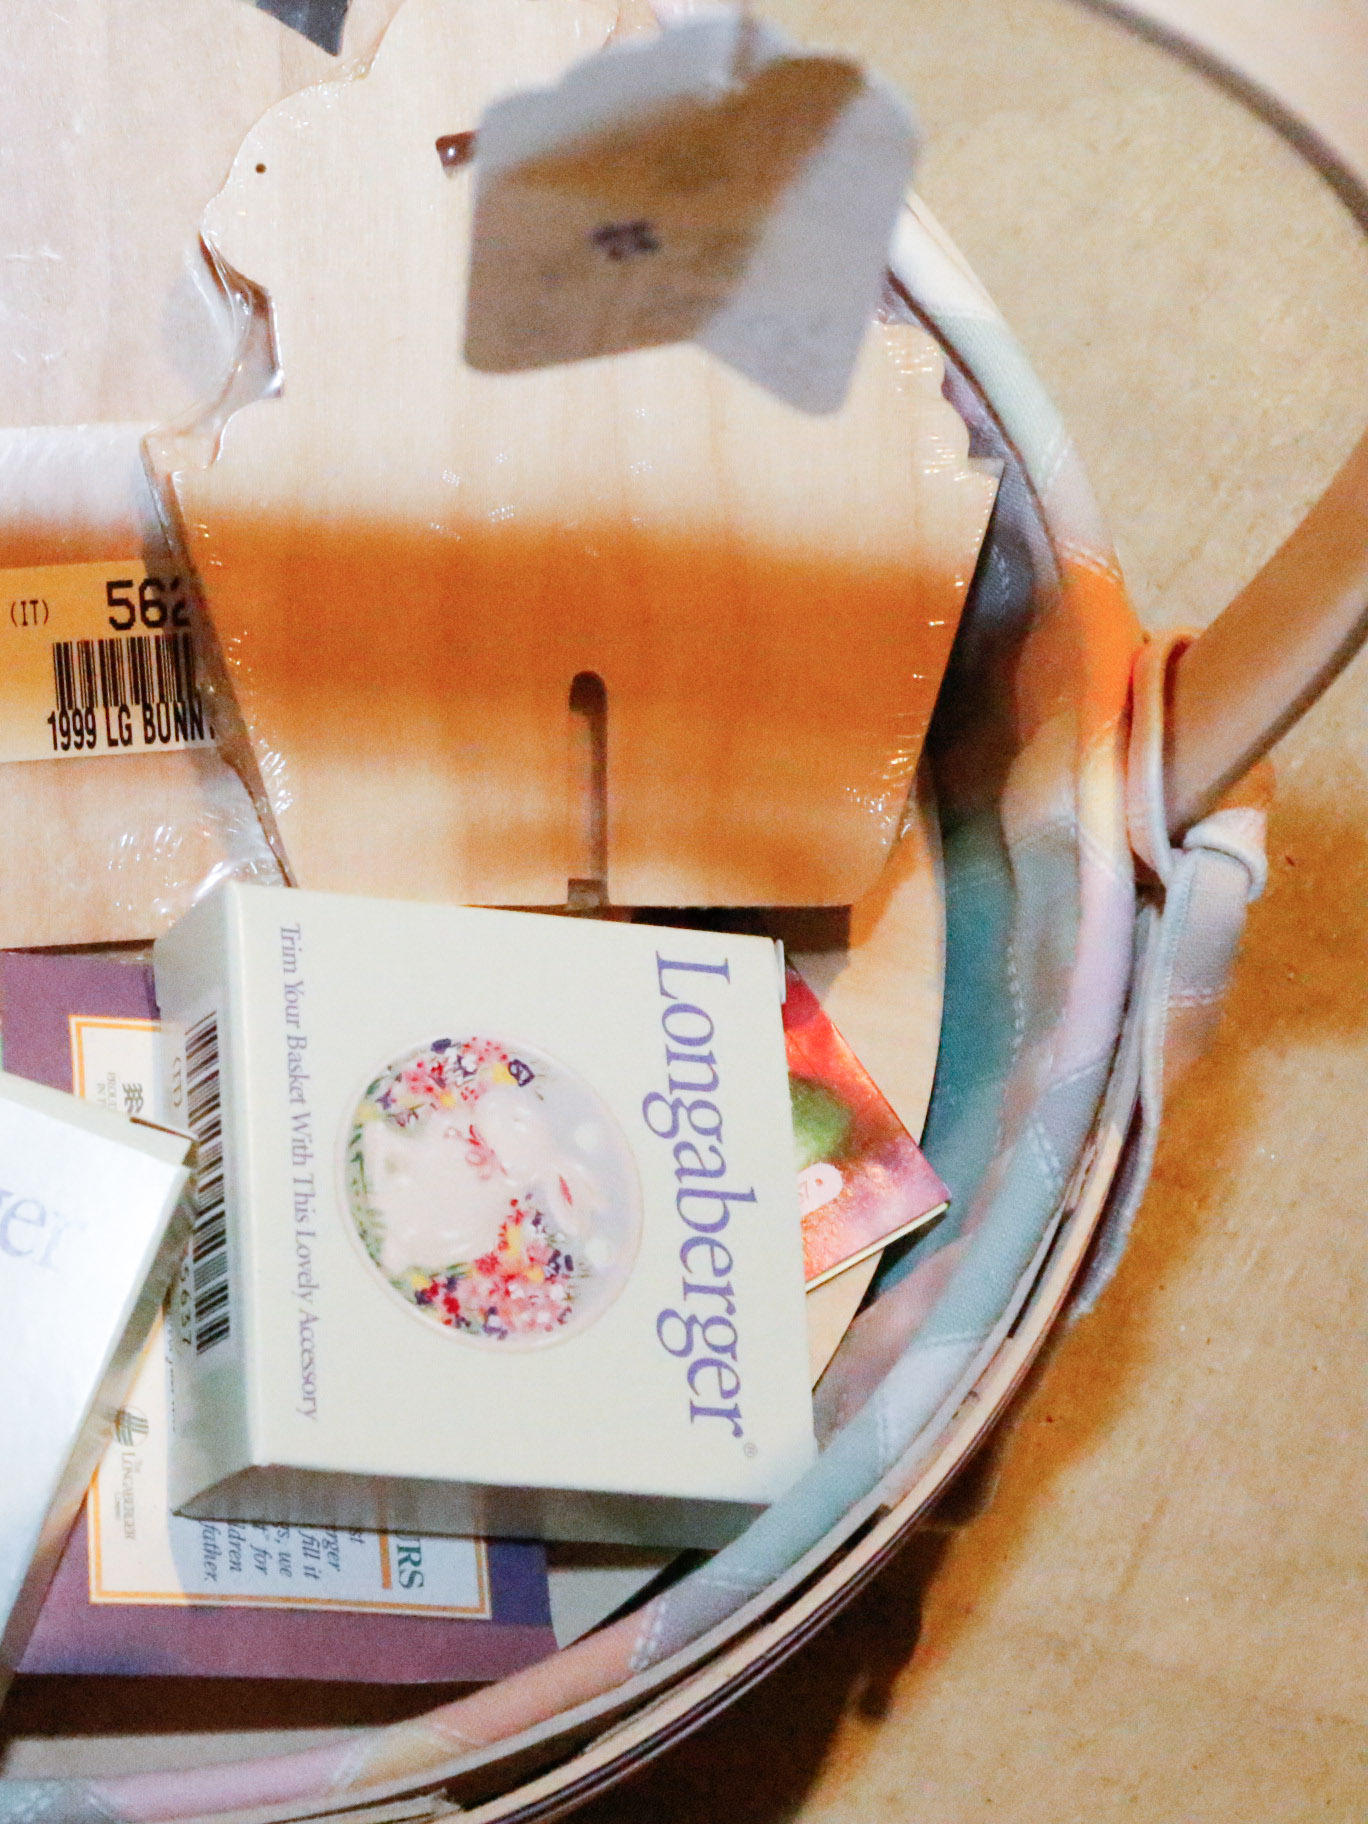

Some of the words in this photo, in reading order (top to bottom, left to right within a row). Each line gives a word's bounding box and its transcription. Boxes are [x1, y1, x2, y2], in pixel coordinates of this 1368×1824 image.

[10, 600, 49, 627] (IT)
[48, 705, 97, 751] 1999
[104, 703, 133, 747] LG
[142, 700, 216, 745] BUNN
[280, 922, 302, 973] Trim
[283, 980, 304, 1028] Your
[285, 1035, 308, 1104] Basket
[290, 1112, 312, 1166] With
[293, 1174, 314, 1222] This
[290, 1230, 318, 1304] Lovely
[294, 1308, 321, 1421] Accessory
[251, 1545, 272, 1576] for
[279, 1553, 292, 1578] we
[299, 1531, 320, 1560] fill
[306, 1567, 321, 1581] it
